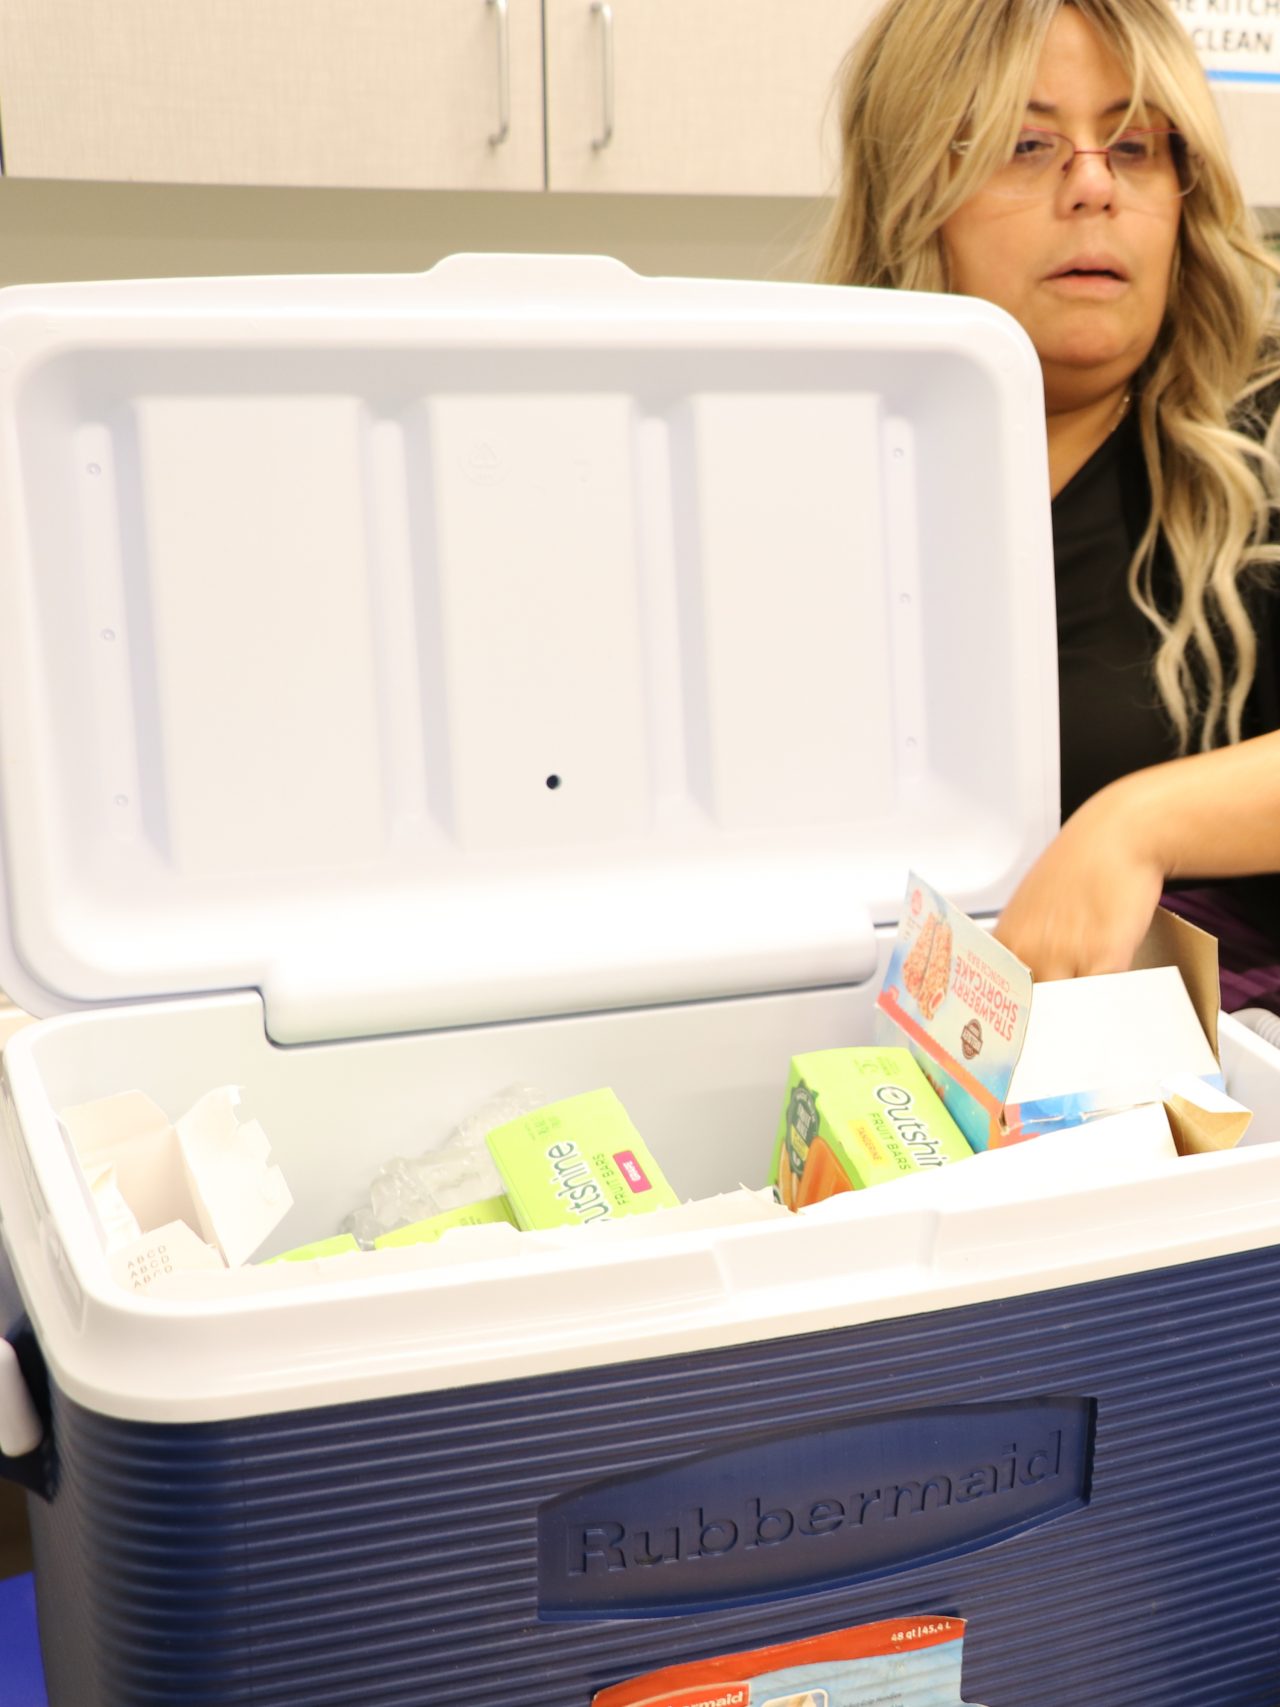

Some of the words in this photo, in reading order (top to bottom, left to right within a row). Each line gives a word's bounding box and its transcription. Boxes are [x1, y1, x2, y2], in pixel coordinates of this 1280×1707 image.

[1191, 26, 1273, 53] CLEAN
[951, 974, 1014, 1042] STRAWBERRY
[956, 955, 1019, 1024] SHORTCAKE
[592, 1153, 615, 1178] BARS
[869, 1112, 894, 1141] FRUIT
[886, 1143, 912, 1170] BARS
[548, 1142, 611, 1224] utshine
[604, 1179, 627, 1206] FRUIT
[567, 1429, 1063, 1577] Rubbermaid
[890, 1631, 904, 1642] 48
